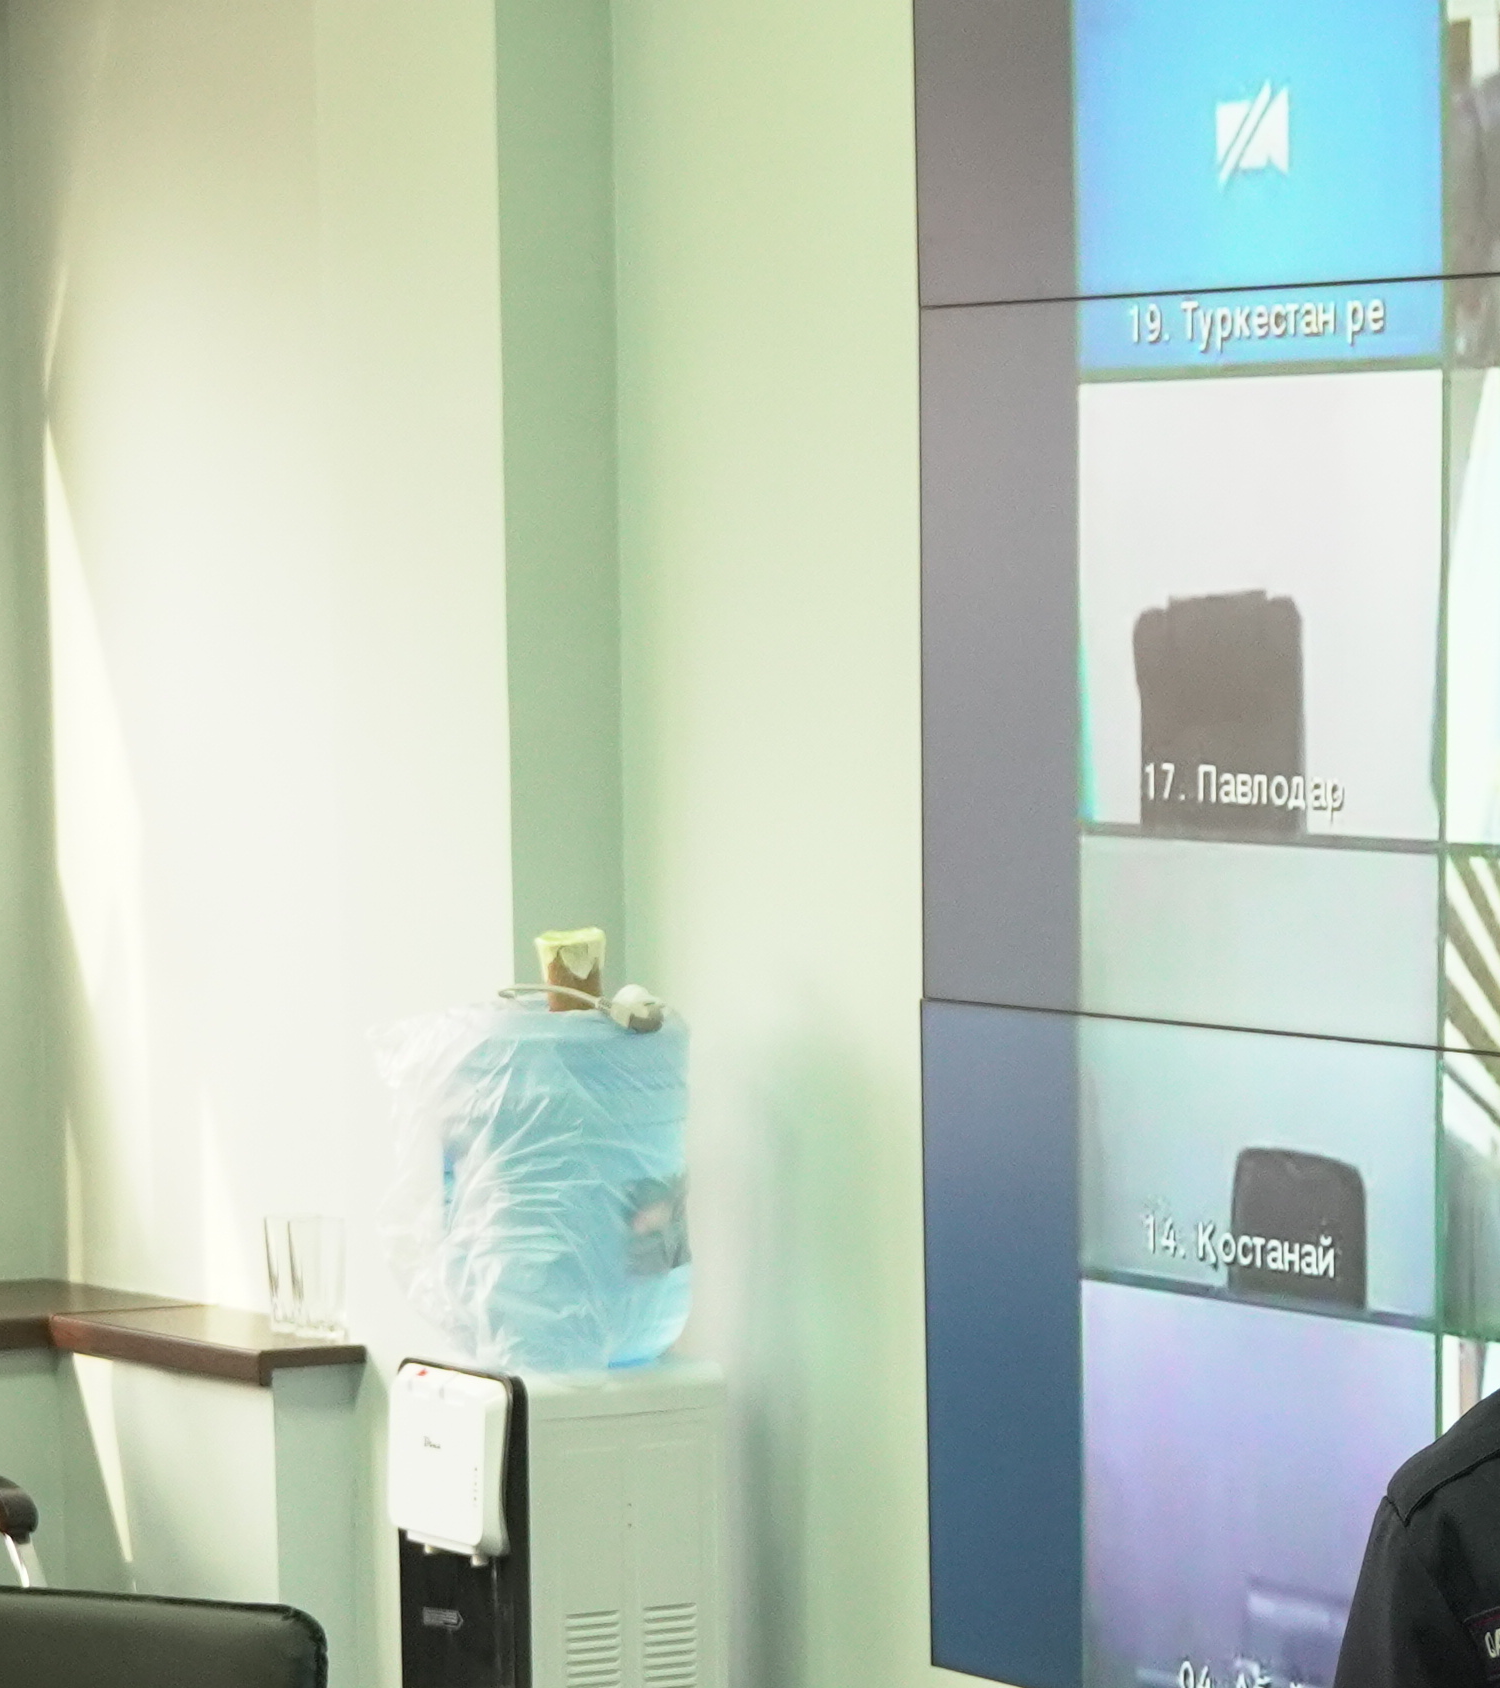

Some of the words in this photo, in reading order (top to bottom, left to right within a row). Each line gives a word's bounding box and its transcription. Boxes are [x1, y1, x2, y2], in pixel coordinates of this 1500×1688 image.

[1129, 302, 1171, 344] 19.
[1181, 299, 1336, 354] Туркестан
[1347, 298, 1386, 347] ре
[1145, 762, 1187, 801] 17.
[1198, 763, 1345, 823] Павлодар
[1145, 1213, 1187, 1258] 14.
